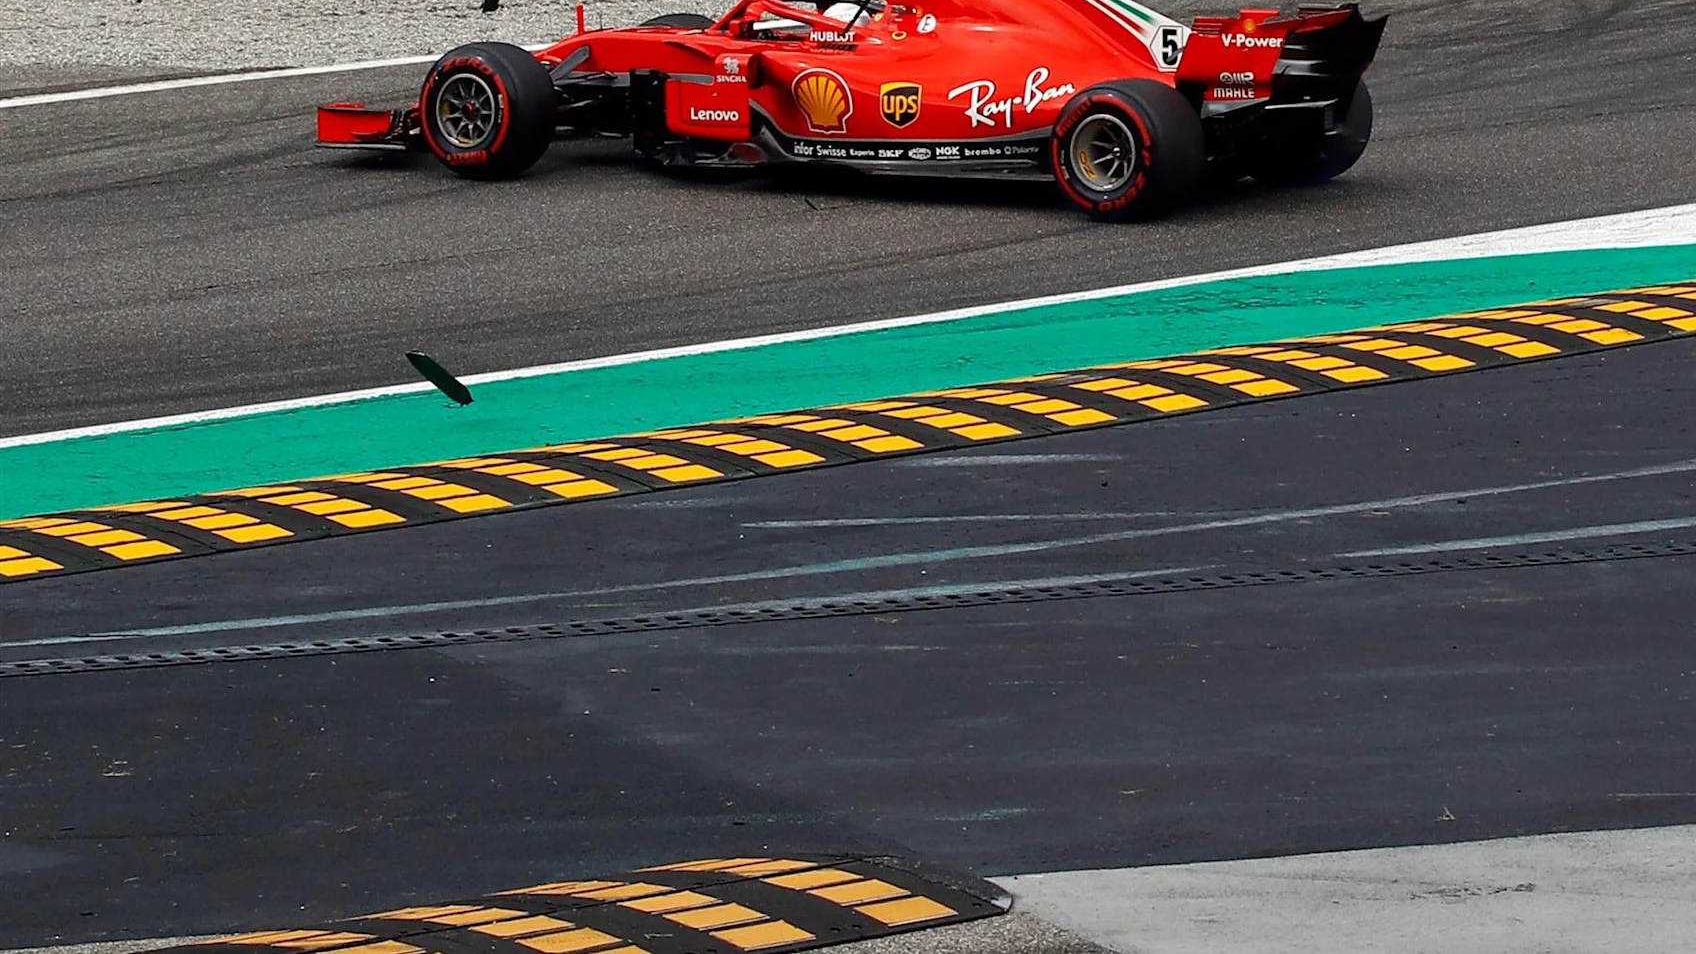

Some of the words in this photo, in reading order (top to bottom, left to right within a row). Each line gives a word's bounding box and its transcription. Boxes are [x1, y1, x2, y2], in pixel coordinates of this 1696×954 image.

[810, 31, 856, 42] HUBLOT
[1221, 33, 1283, 48] V-Power
[1162, 28, 1179, 66] 5
[1213, 88, 1255, 98] MAHLE
[690, 107, 740, 121] Lenovo
[882, 95, 918, 122] ups
[816, 145, 847, 157] Swisse
[964, 146, 1001, 156] brembo
